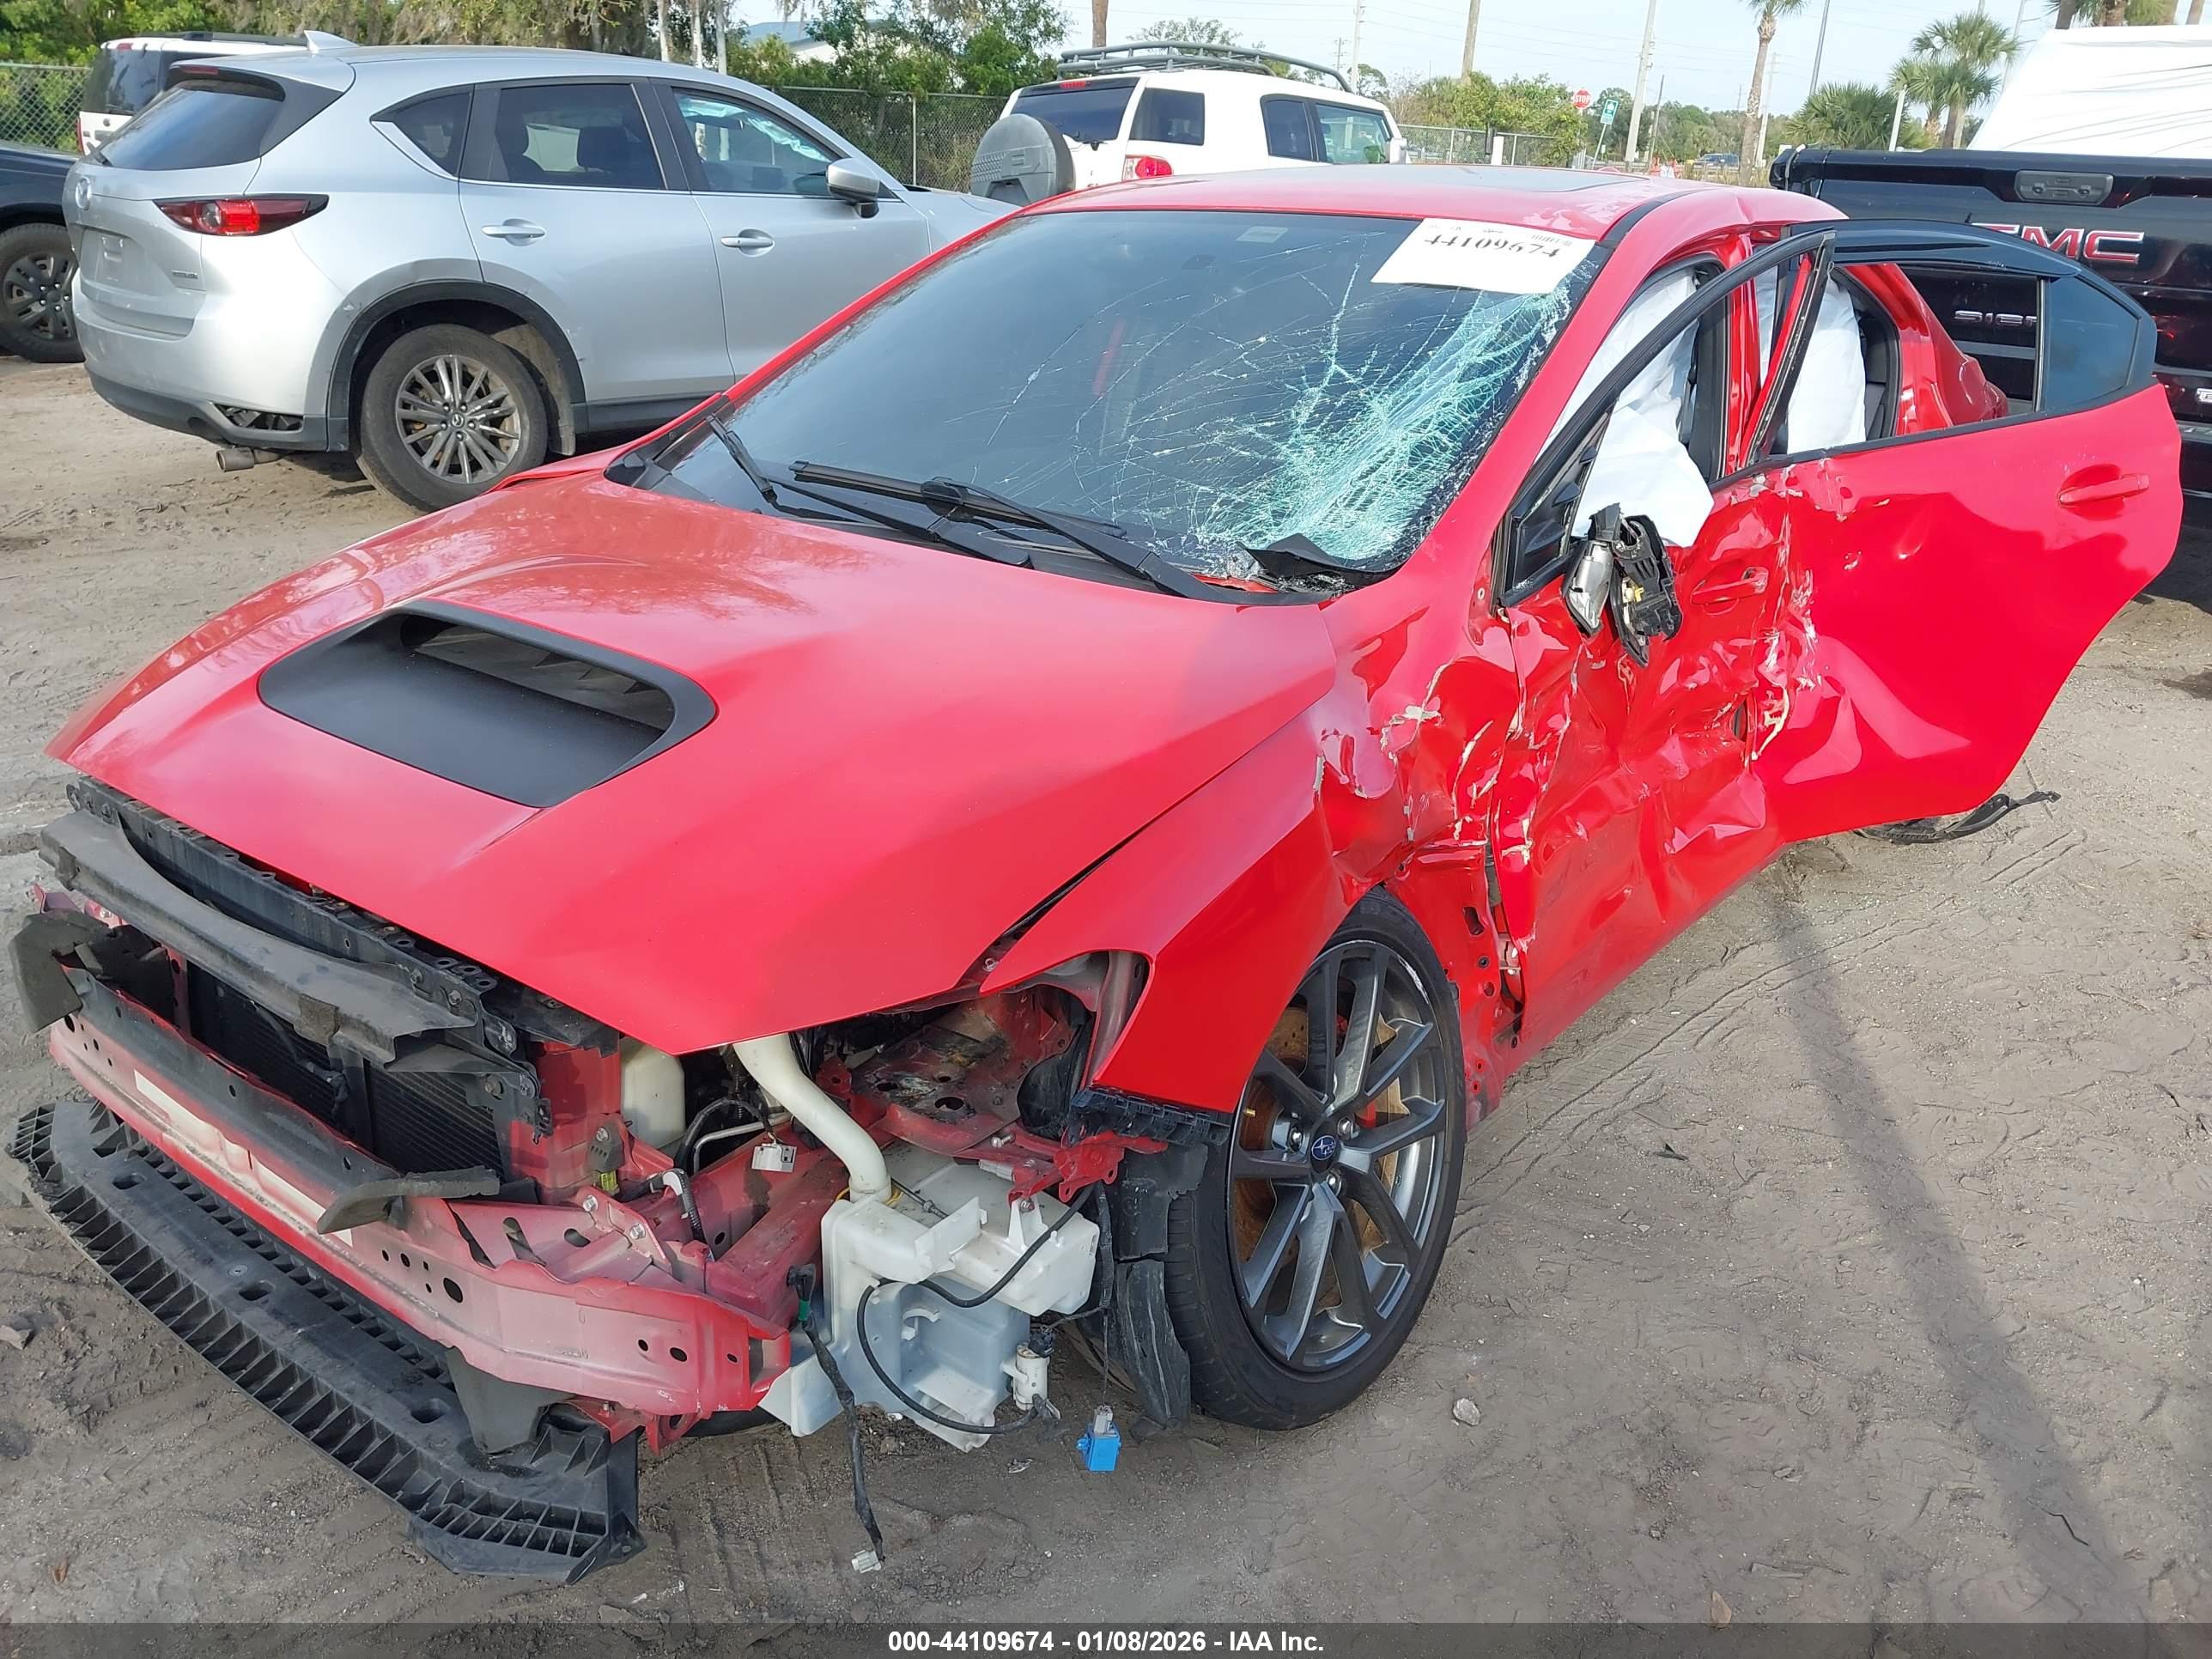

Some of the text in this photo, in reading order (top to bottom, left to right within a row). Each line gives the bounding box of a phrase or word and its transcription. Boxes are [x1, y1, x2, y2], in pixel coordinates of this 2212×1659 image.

[1575, 94, 1591, 104] STOP
[1425, 234, 1560, 258] 44109674
[1972, 222, 2145, 264] MC
